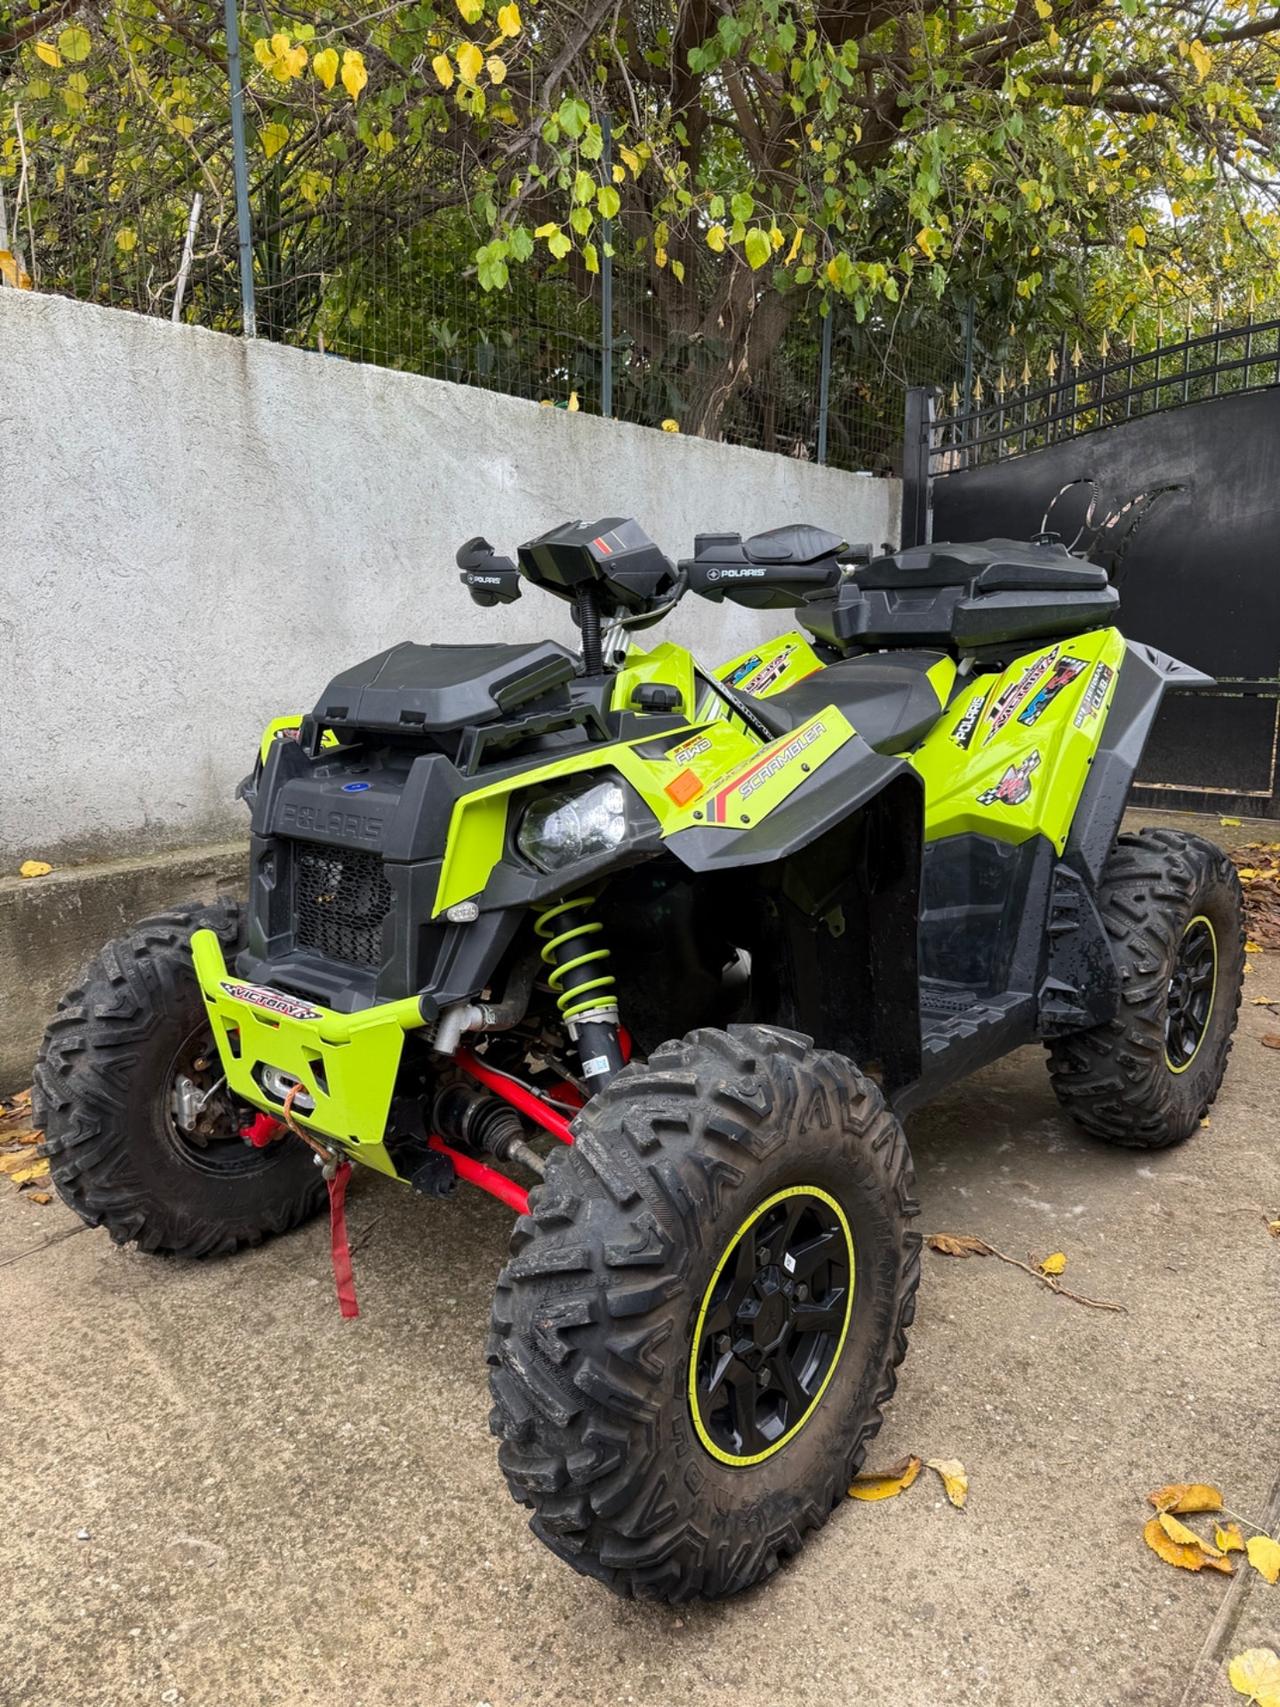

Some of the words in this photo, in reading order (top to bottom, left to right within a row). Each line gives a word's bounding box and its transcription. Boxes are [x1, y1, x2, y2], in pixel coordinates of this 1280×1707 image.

[474, 575, 501, 584] POLARIS
[720, 568, 766, 578] POLARIS
[955, 697, 986, 741] POLARIS
[675, 737, 712, 766] AWD
[738, 722, 827, 801] SCRAMBLER
[281, 803, 384, 841] POLARIS
[236, 987, 299, 1014] VICTORY
